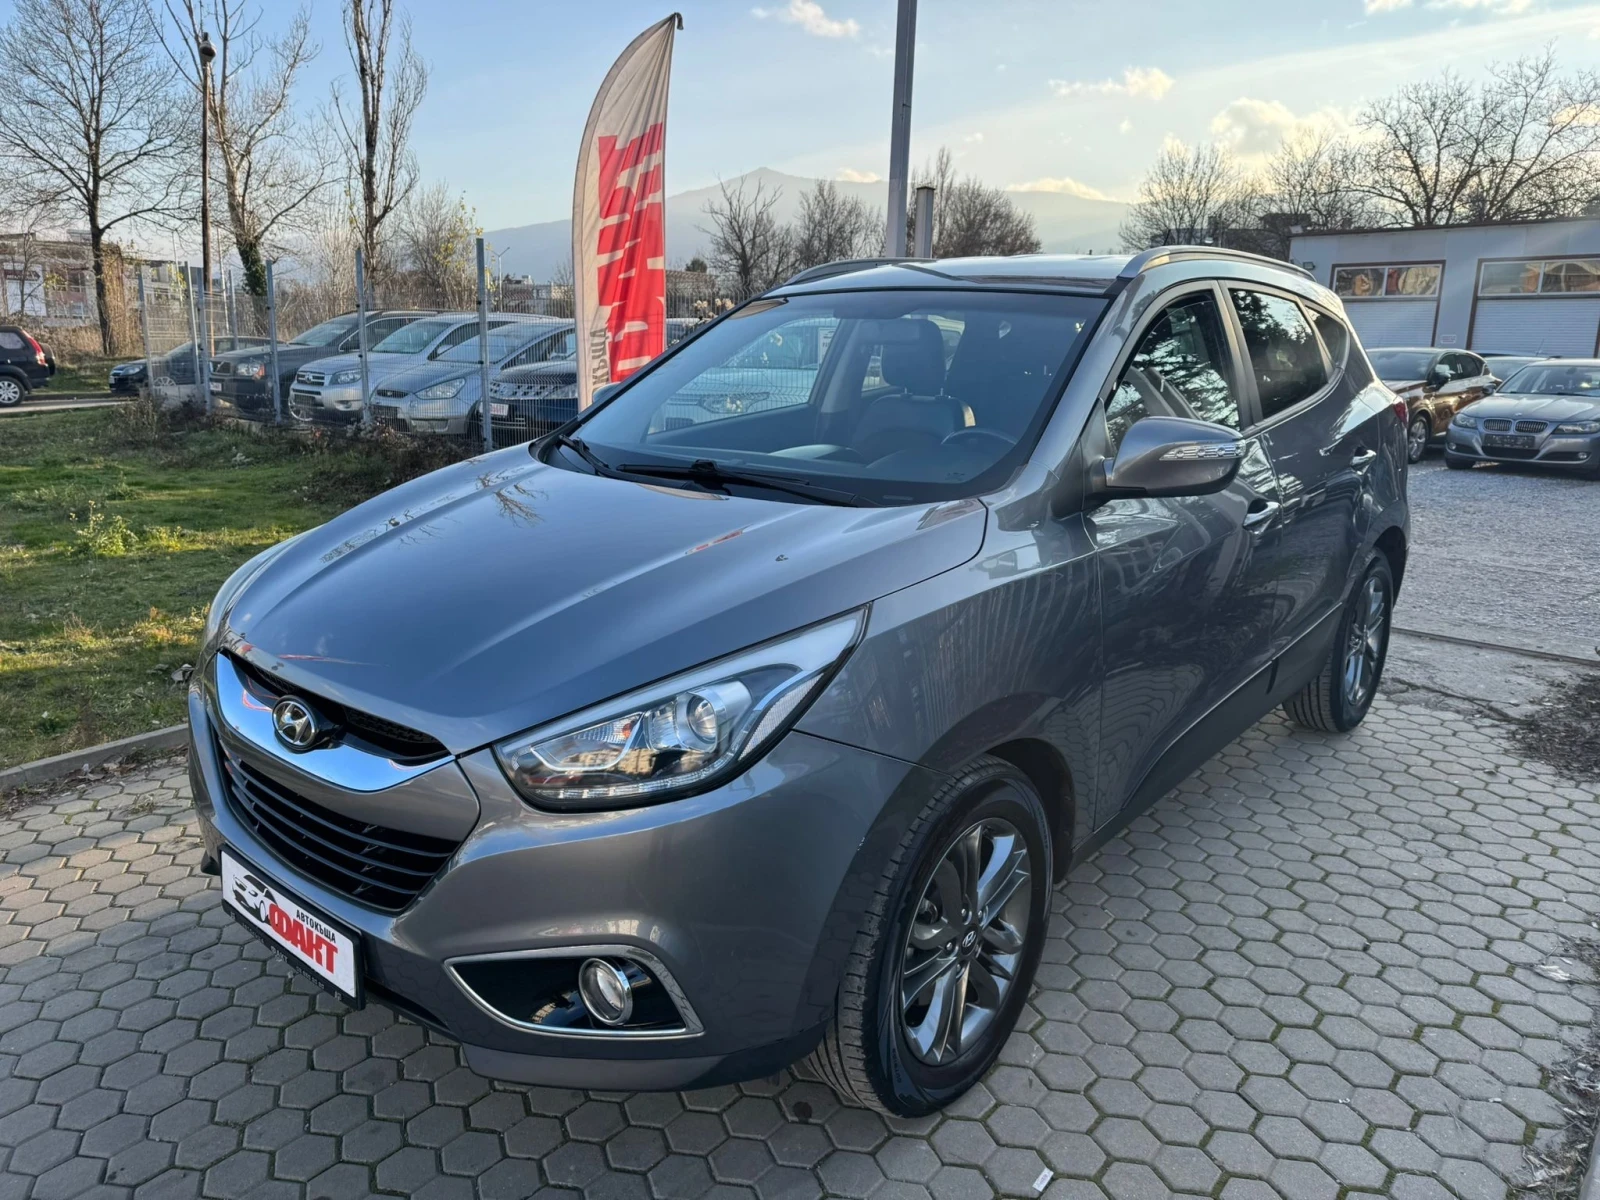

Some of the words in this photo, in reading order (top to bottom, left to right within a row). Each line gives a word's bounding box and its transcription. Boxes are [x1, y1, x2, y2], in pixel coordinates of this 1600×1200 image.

[590, 327, 609, 398] КЪЩА
[268, 903, 338, 974] ФАКТ
[296, 909, 336, 943] АВТОКЪЩА
